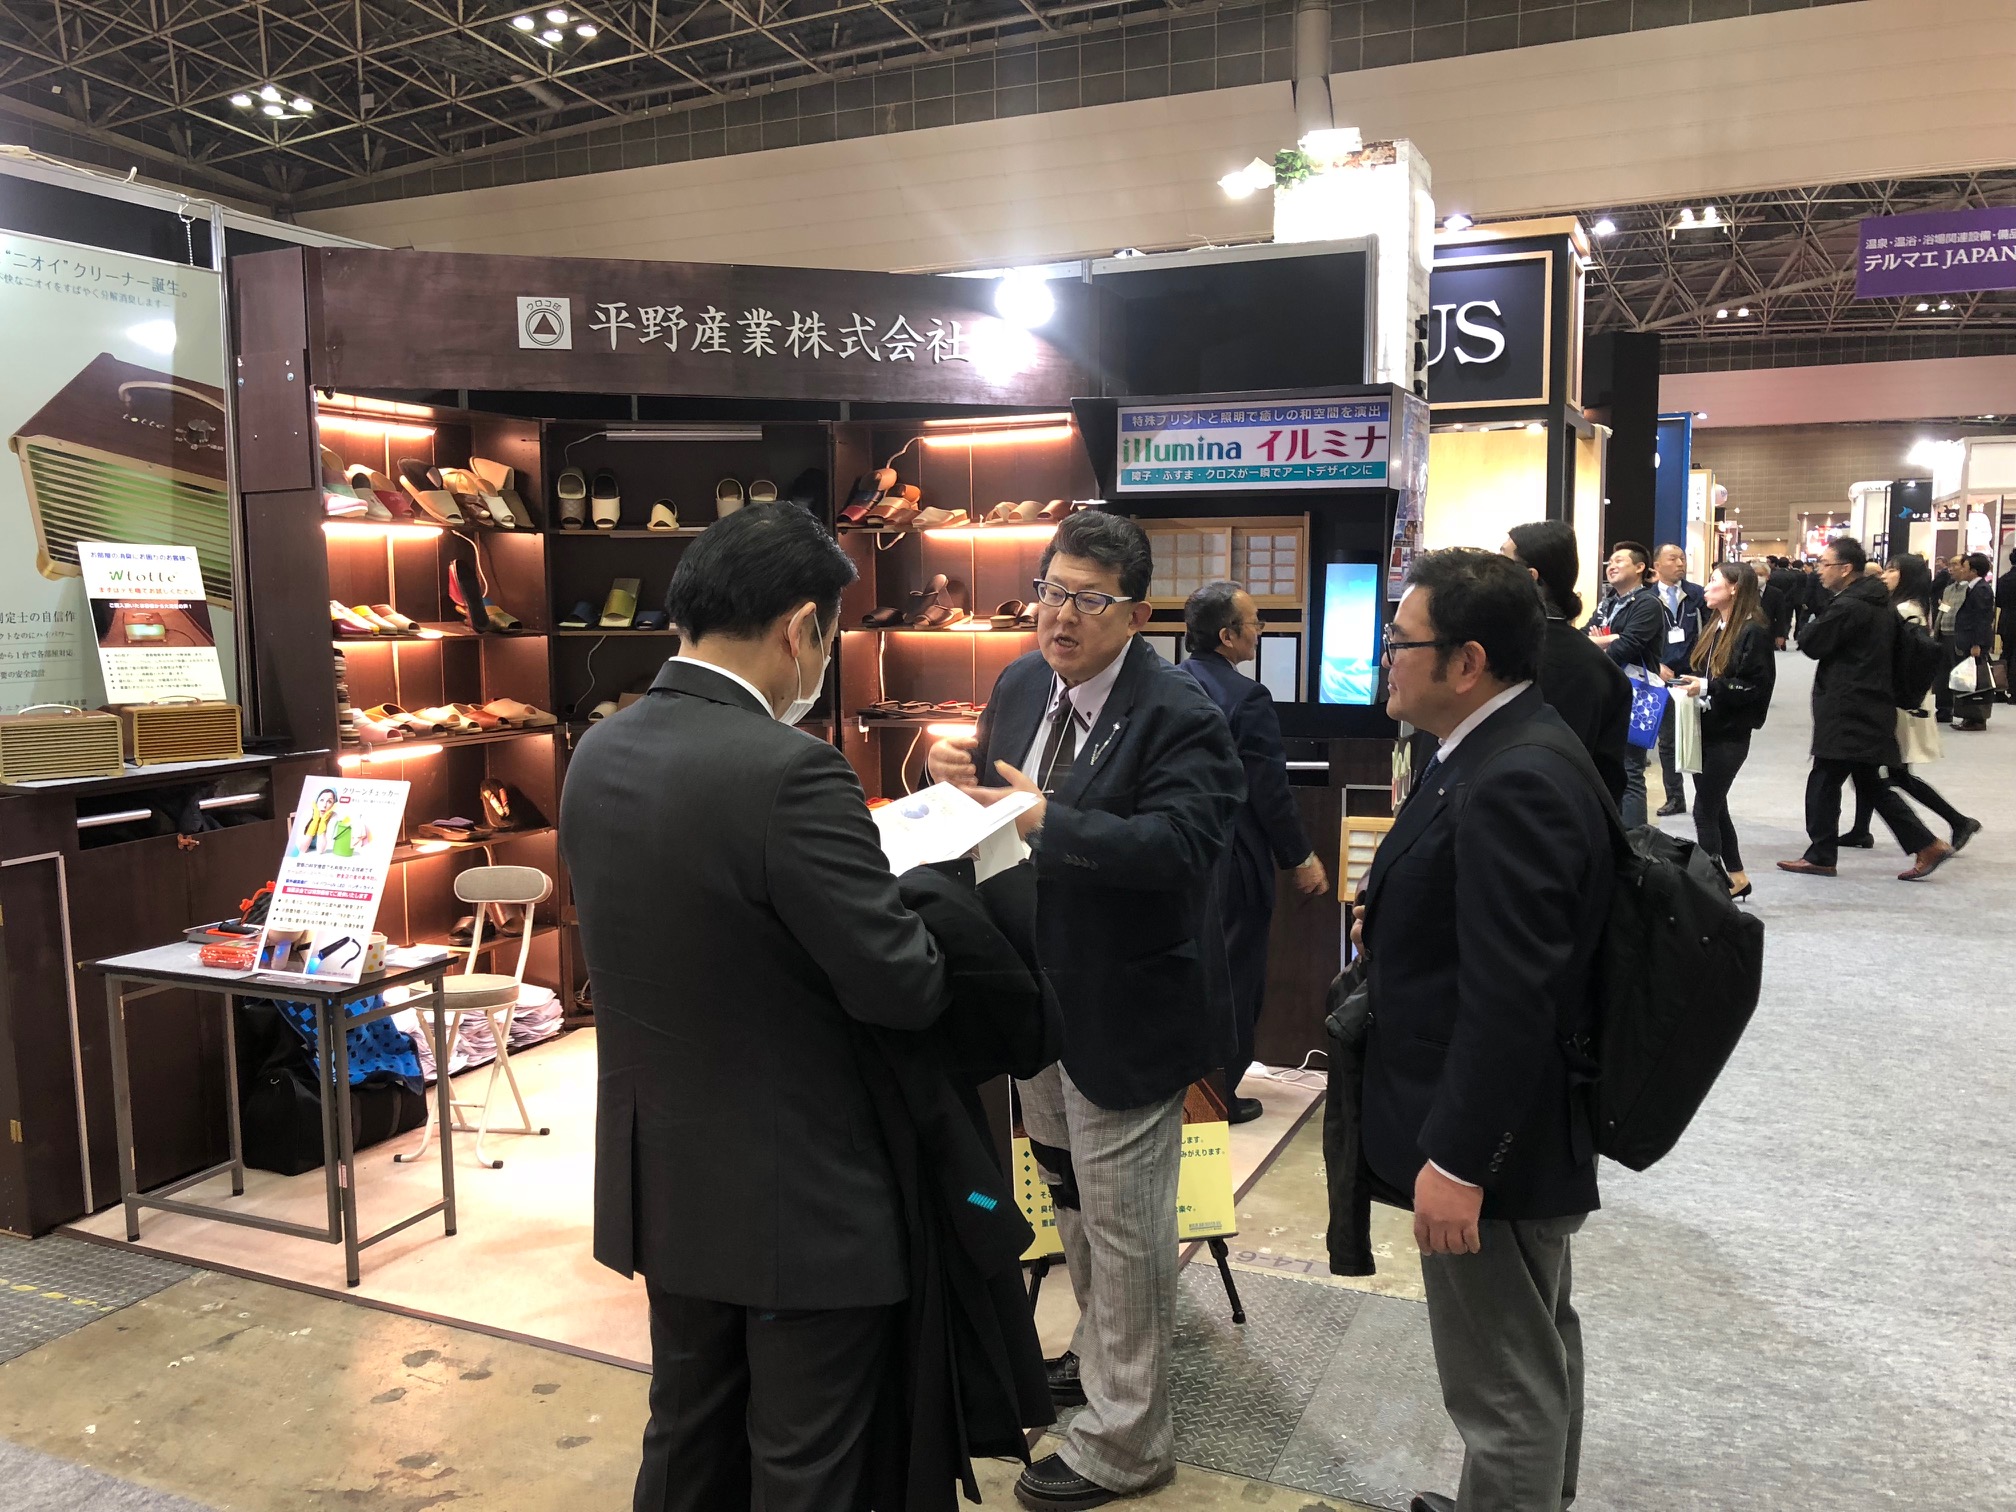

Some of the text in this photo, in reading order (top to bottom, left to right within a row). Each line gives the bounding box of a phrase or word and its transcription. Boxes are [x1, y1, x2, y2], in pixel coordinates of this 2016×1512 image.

[1864, 245, 2016, 272] テルマエ JAPAN
[526, 300, 562, 312] ウロコ印
[588, 301, 971, 364] 平野産業株式会社
[1132, 405, 1381, 426] 特殊プリントと照明で癒しの和空間を演出
[1122, 425, 1387, 463] illumina イルミナ
[1131, 464, 1373, 482] 障子・ふすま・クロスが一瞬でアートデザインに
[342, 787, 400, 797] クリーンチェッカー
